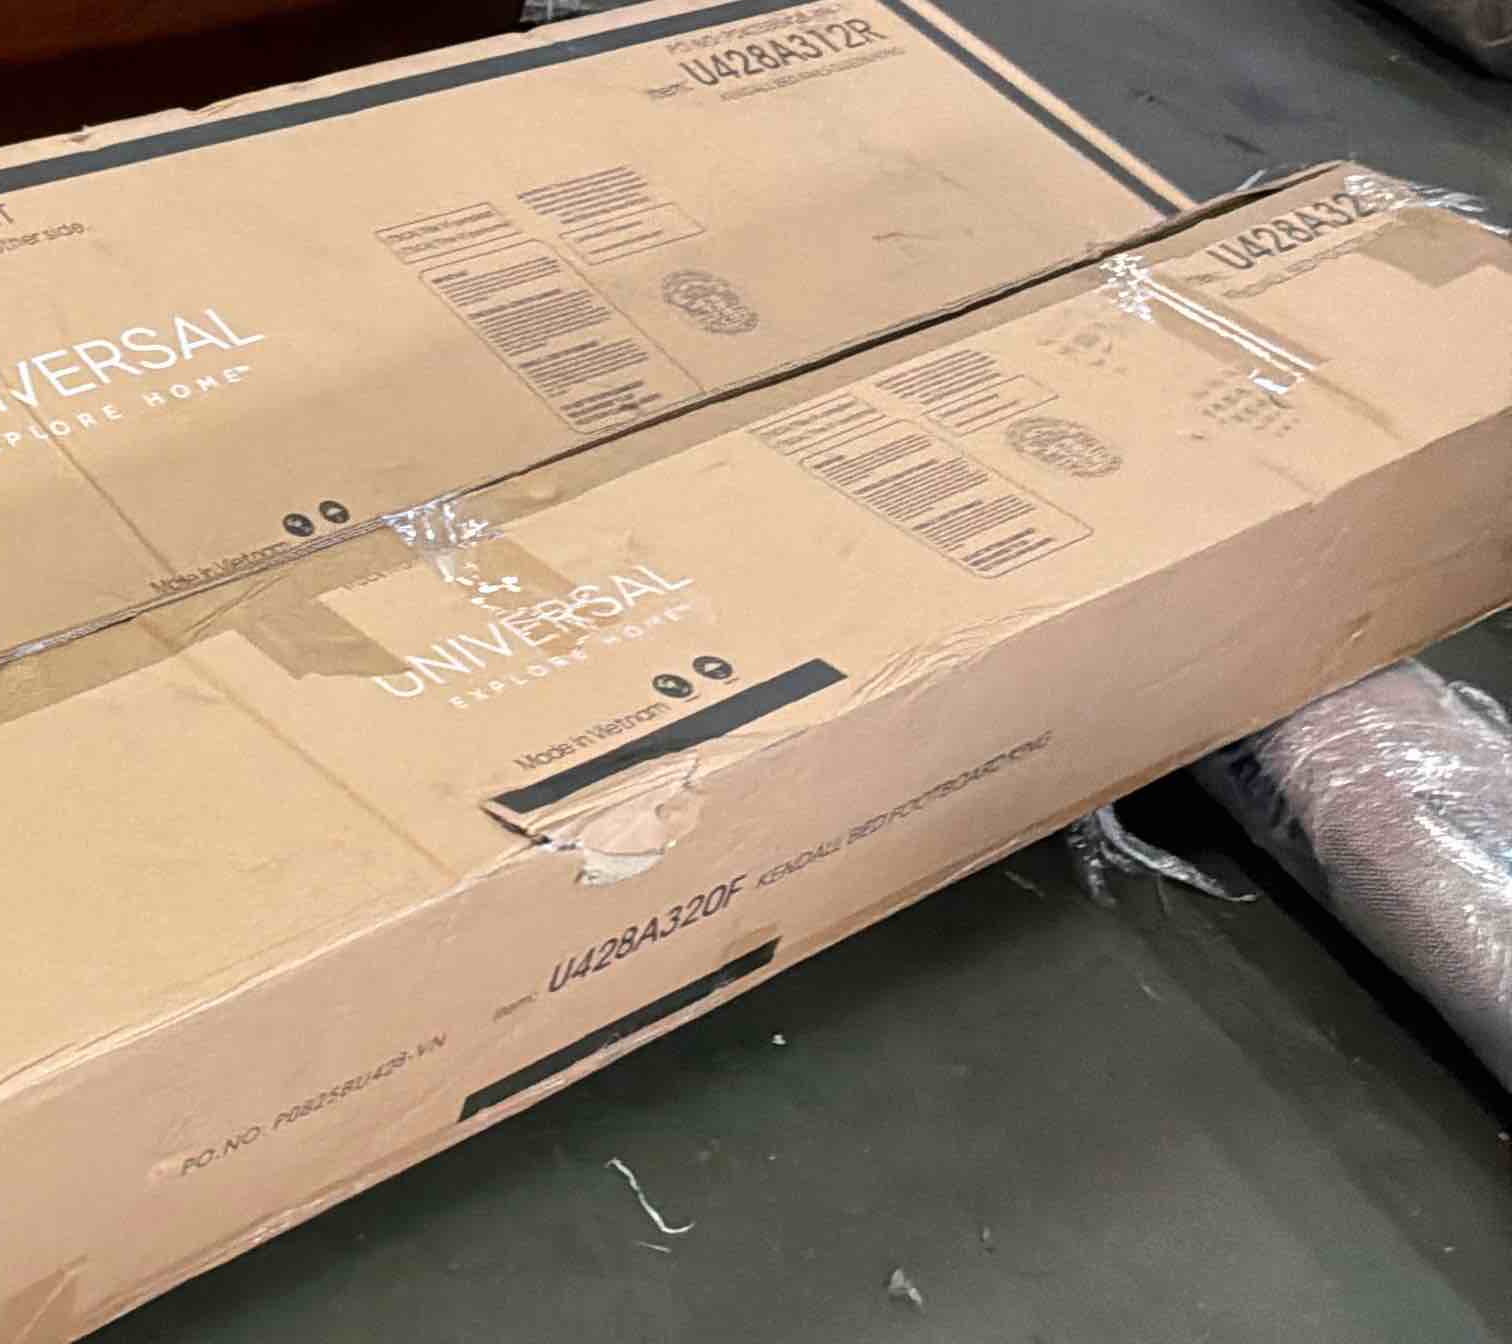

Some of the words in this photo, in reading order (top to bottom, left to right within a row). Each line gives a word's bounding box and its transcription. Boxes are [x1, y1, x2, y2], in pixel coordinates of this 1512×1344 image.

[680, 18, 888, 88] U428A312R
[373, 565, 694, 699] UNIVERSAL
[514, 740, 575, 771] Made
[591, 700, 673, 739] Vietnam
[546, 872, 750, 995] U428A320F
